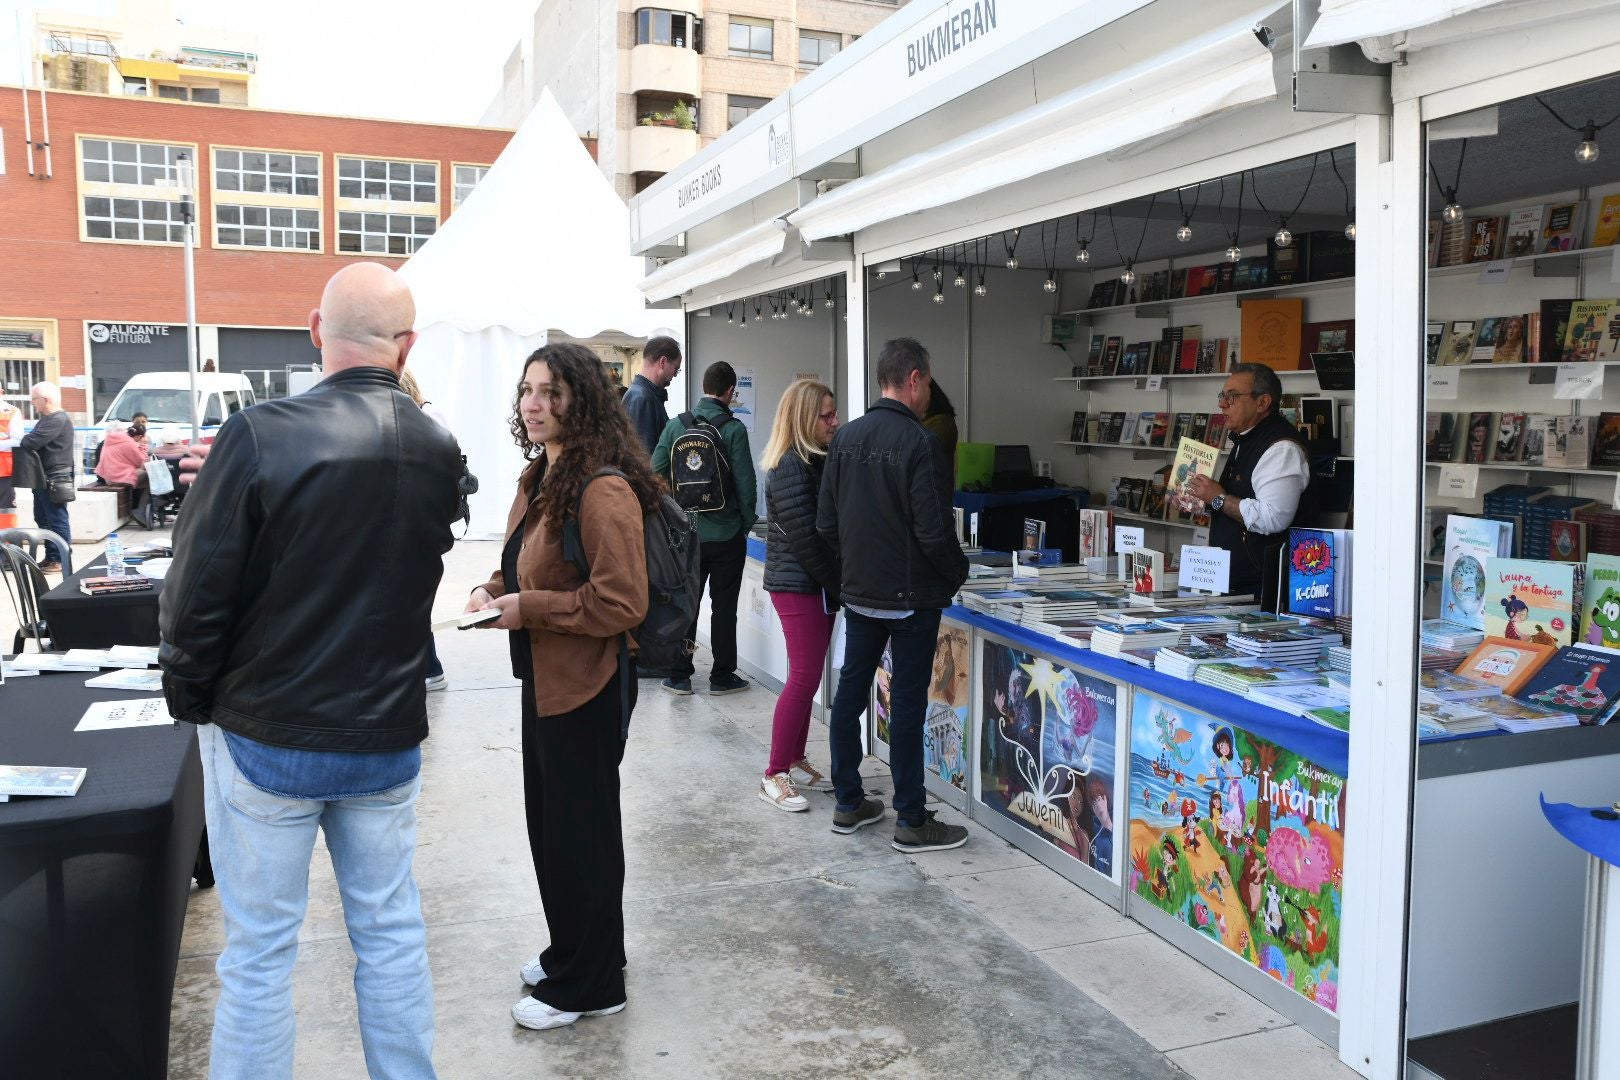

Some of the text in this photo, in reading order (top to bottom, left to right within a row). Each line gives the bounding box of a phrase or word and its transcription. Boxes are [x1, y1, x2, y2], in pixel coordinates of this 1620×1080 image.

[907, 0, 997, 78] BUKMERAN
[678, 164, 722, 208] BUNKER BOOKS
[1477, 221, 1488, 236] RE
[1473, 243, 1489, 257] ZOS
[110, 324, 170, 336] ALICANTE
[110, 334, 152, 344] FUTURA
[677, 441, 709, 452] HOGWARTS
[1183, 443, 1214, 461] HISTORIAS
[1499, 571, 1532, 583] Laura
[1295, 580, 1330, 601] K-CÓMIC
[1512, 584, 1518, 592] y
[1531, 583, 1564, 599] tortuga
[1296, 761, 1343, 789] Bukmeran
[1262, 770, 1340, 829] Infantil
[1017, 790, 1065, 832] Juvenil
